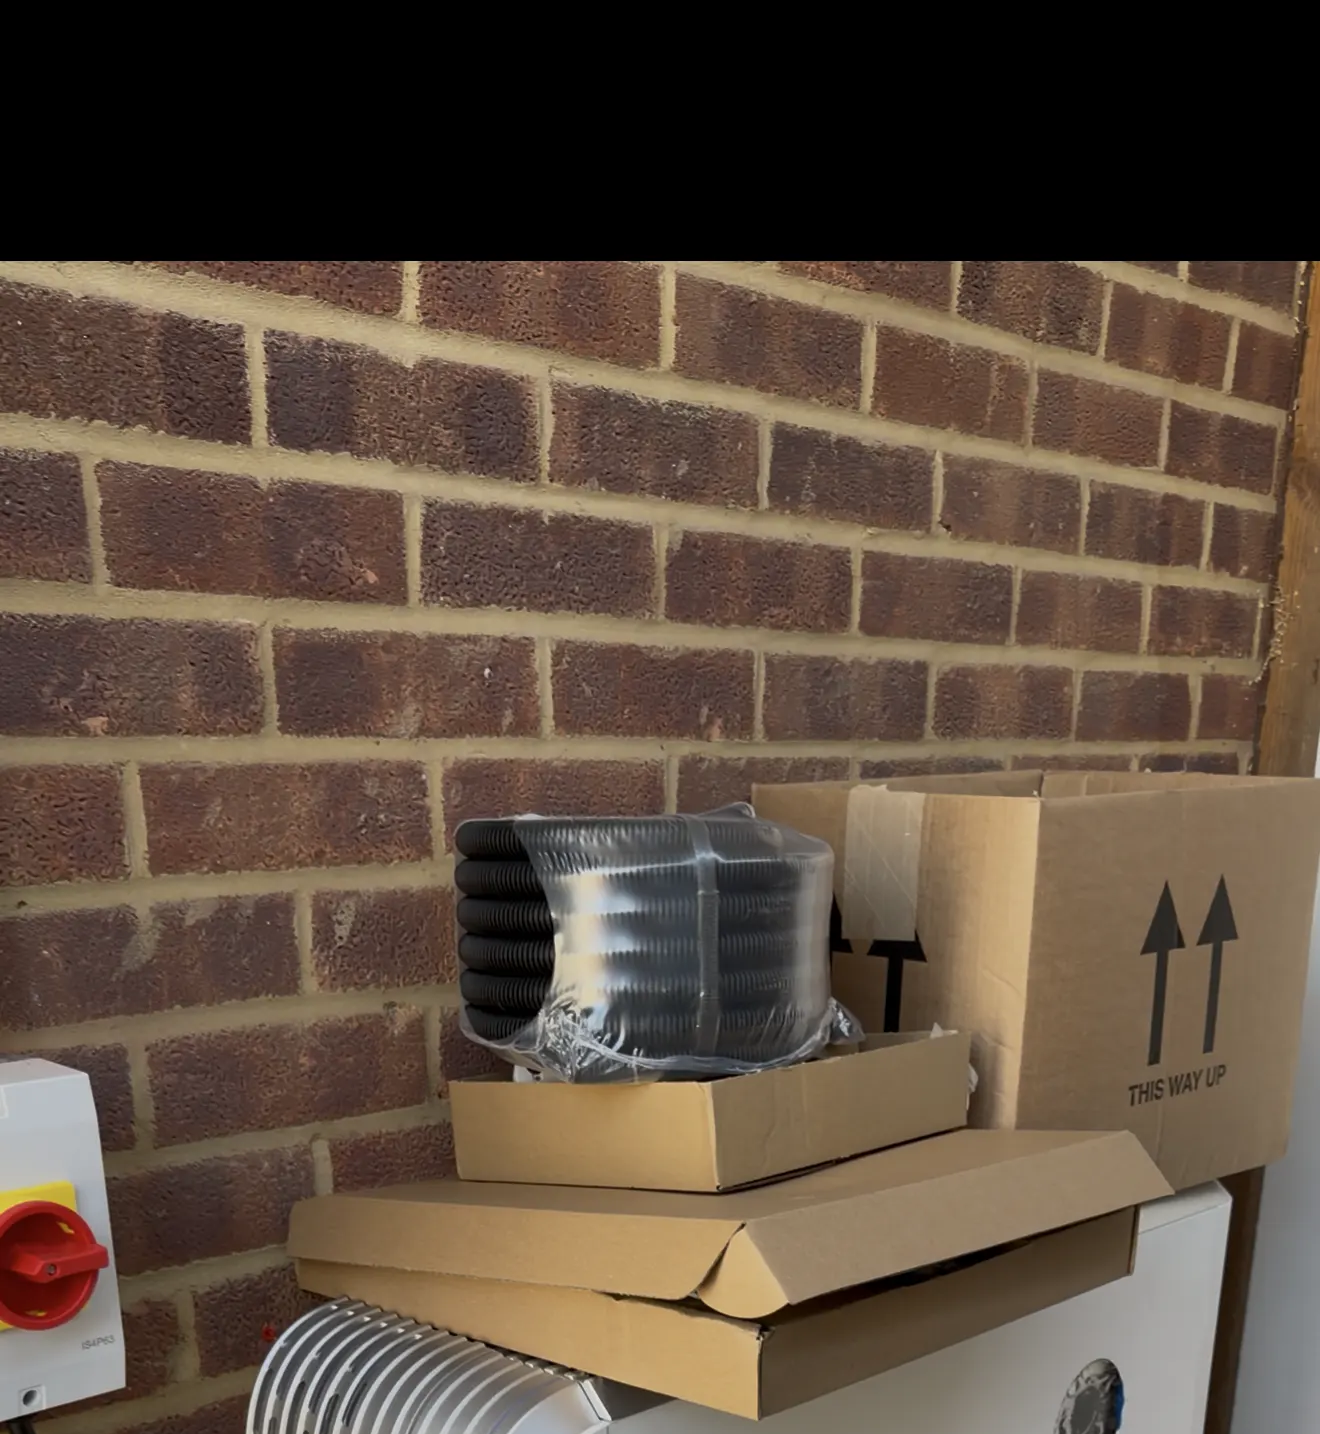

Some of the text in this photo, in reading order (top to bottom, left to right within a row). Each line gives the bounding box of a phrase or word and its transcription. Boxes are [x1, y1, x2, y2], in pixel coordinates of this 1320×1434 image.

[1128, 1064, 1227, 1107] THIS WAY UP
